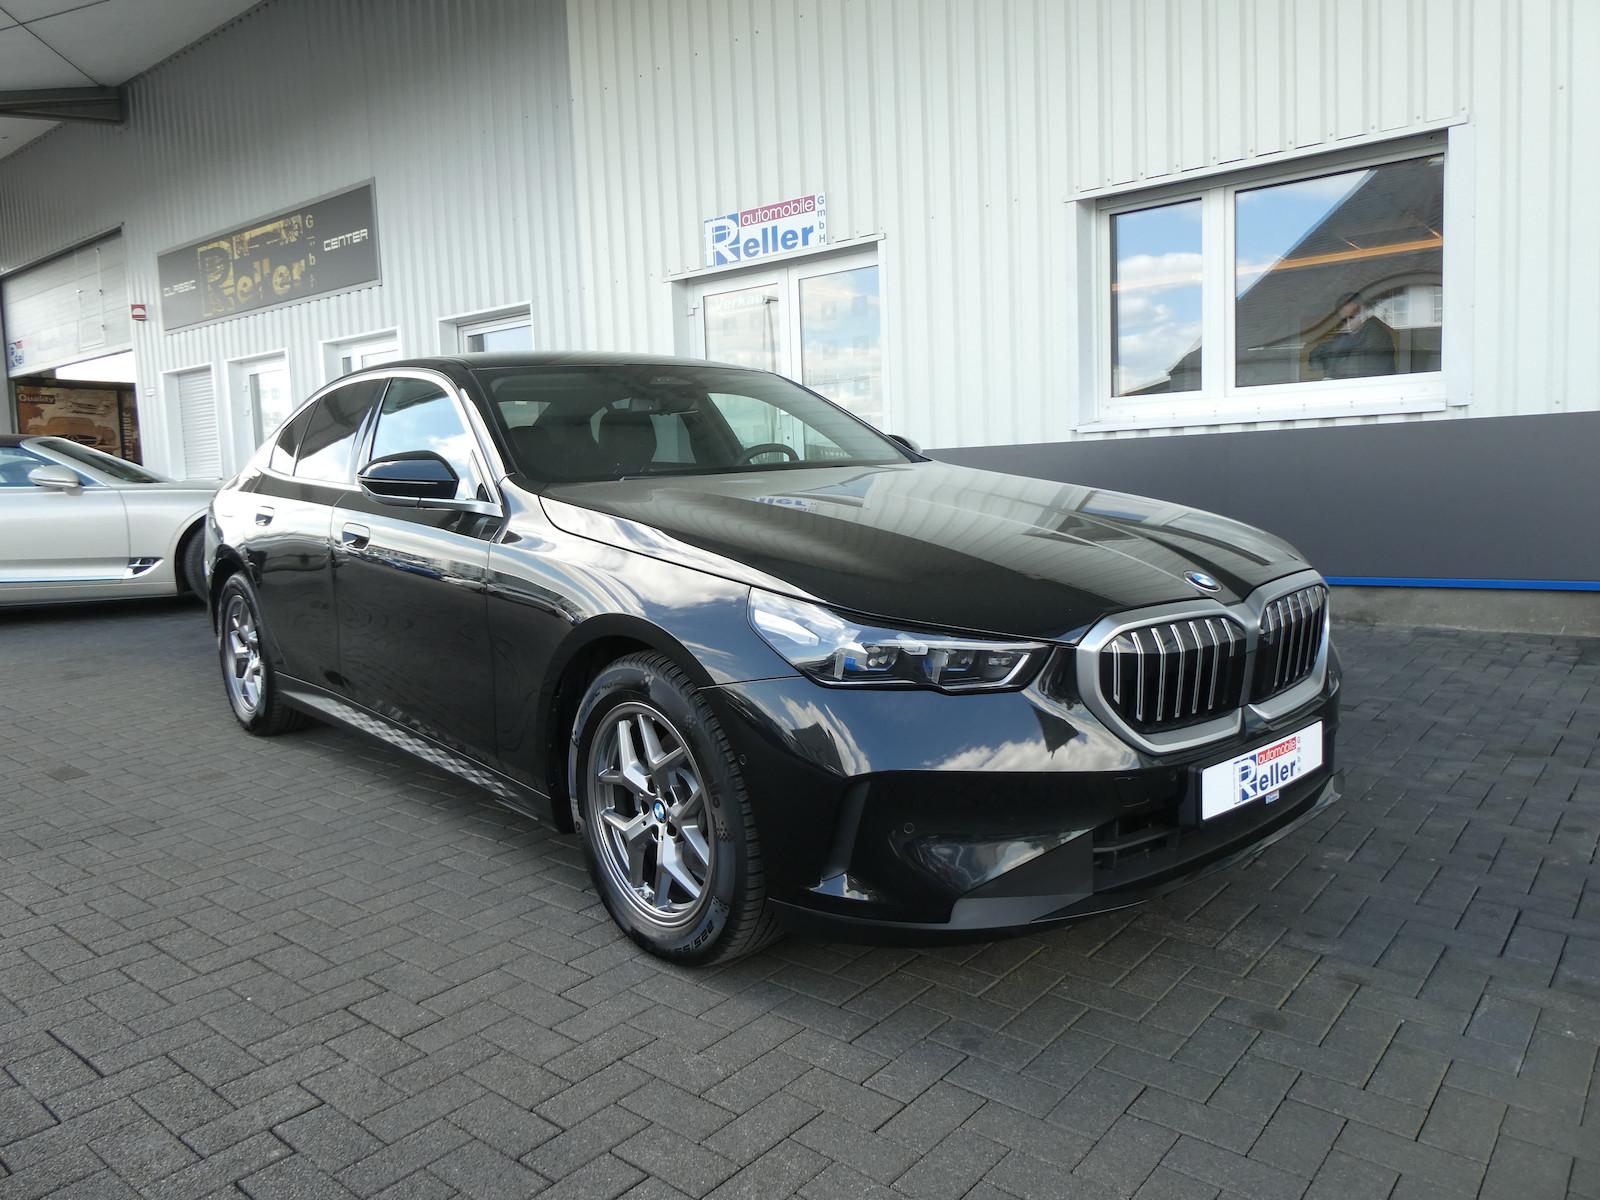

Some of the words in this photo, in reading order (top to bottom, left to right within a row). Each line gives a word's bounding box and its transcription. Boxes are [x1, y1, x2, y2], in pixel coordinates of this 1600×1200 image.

[742, 198, 814, 226] automobile
[323, 228, 369, 252] CENTER
[704, 215, 814, 267] Reller
[1258, 739, 1296, 764] automobile
[1233, 757, 1296, 804] Reller
